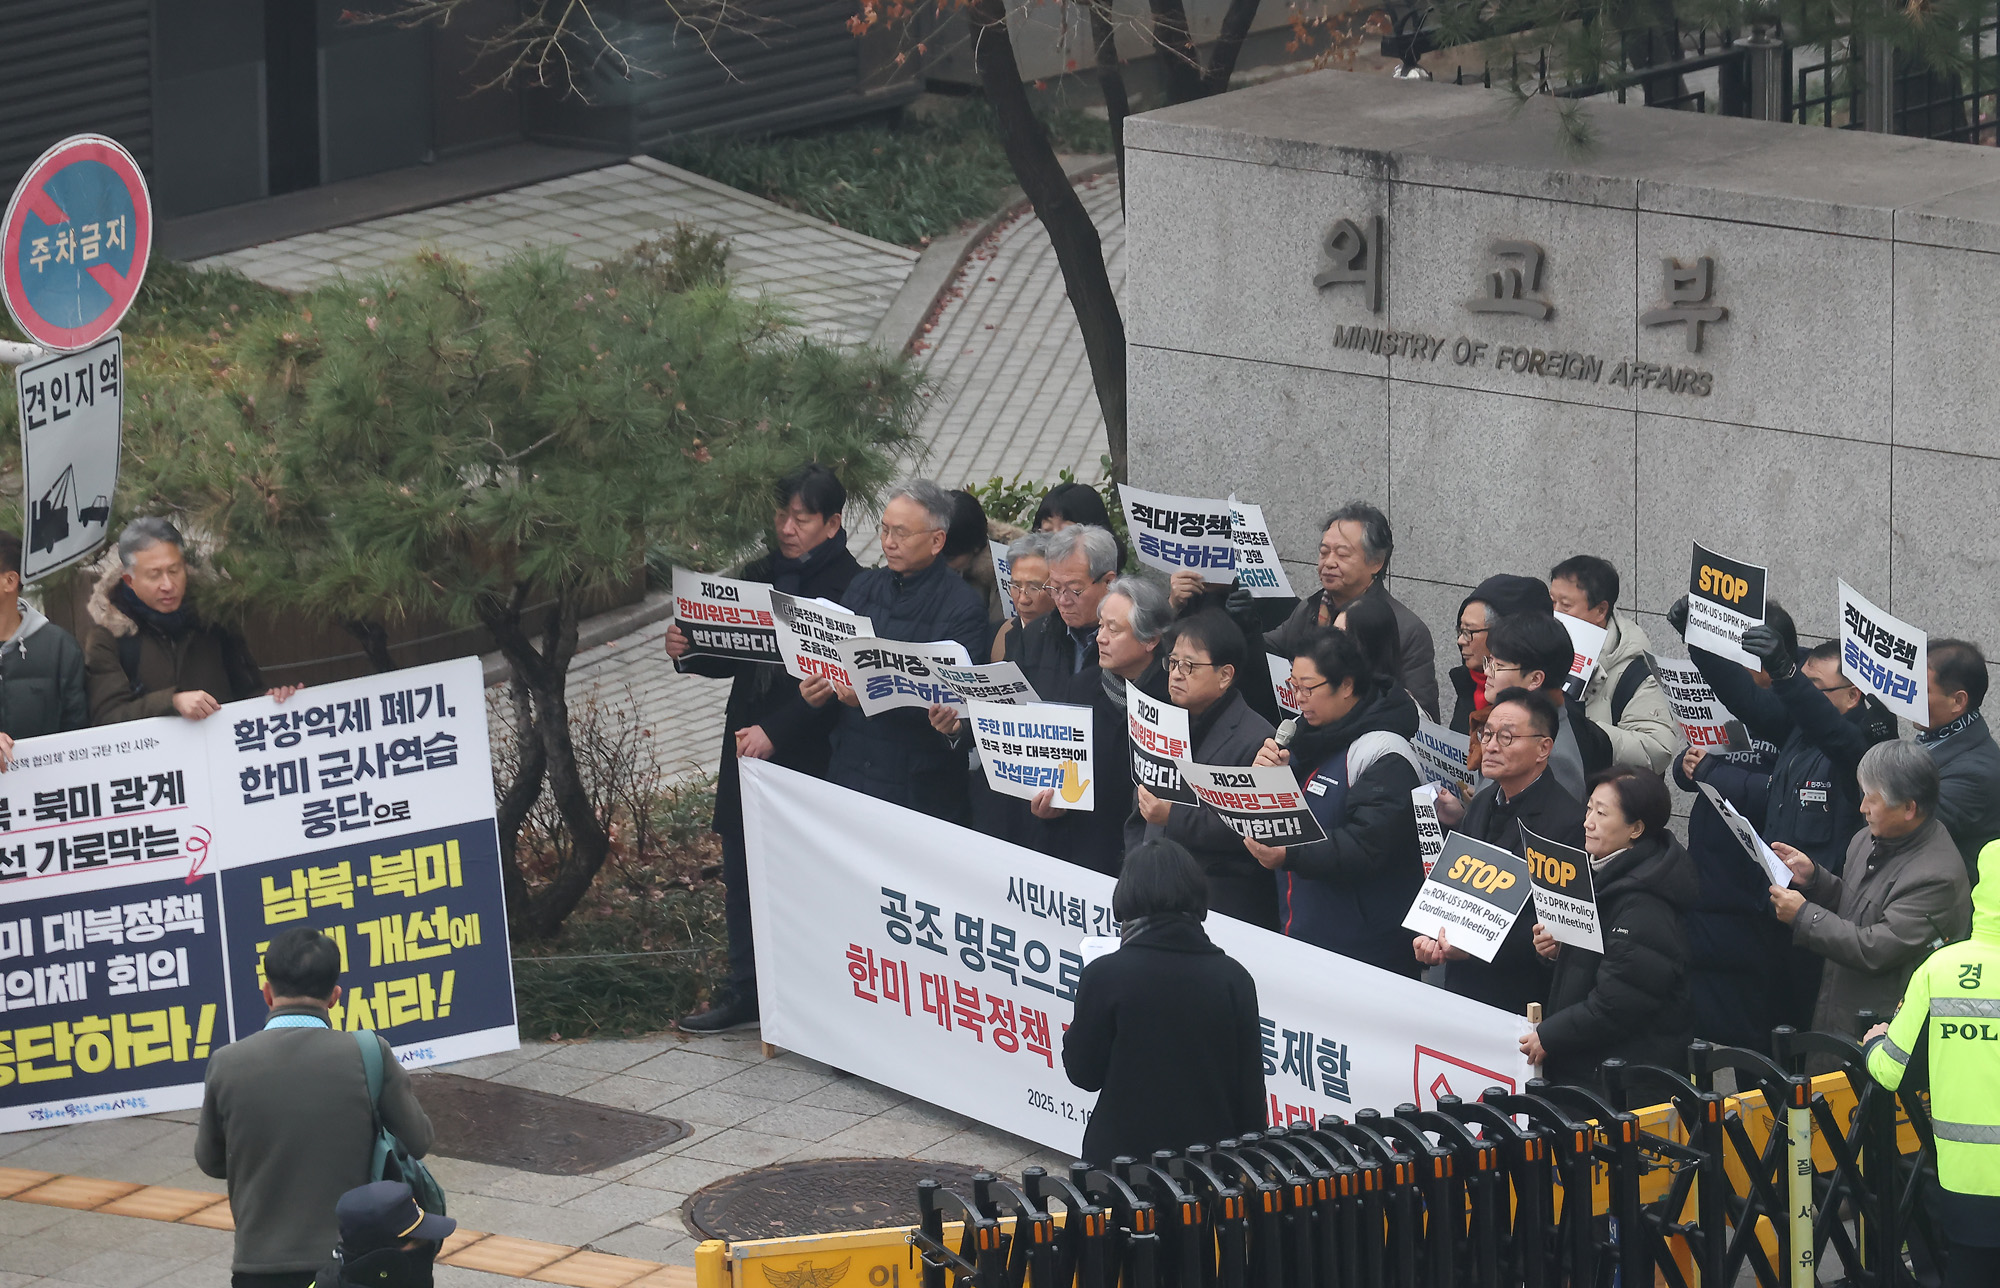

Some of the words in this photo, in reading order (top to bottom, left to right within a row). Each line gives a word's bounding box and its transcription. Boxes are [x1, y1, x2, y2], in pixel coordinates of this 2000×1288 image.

[30, 215, 127, 274] 주차금지
[1333, 324, 1446, 363] MINISTRY
[1452, 336, 1488, 367] OF
[1496, 344, 1603, 384] FOREIGN
[1608, 361, 1714, 397] AFFAIRS
[24, 352, 119, 430] 견인지역
[1130, 502, 1232, 540] 적대정책
[701, 582, 740, 602] 제2의
[1699, 564, 1749, 604] STOP
[782, 603, 824, 627] 대북정책
[790, 620, 812, 637] 한미
[1689, 615, 1728, 639] Coordination
[1723, 612, 1740, 628] DPRK
[692, 629, 776, 653] 반대한다!
[1845, 602, 1918, 670] 적대정책
[937, 667, 990, 684] 외교부는
[1845, 638, 1918, 704] 중단하라
[233, 698, 371, 751] 확장억제
[381, 684, 456, 727] 폐기,
[977, 717, 1000, 736] 주한
[1003, 721, 1016, 738] 미
[1018, 722, 1085, 743] 대사대리는
[1138, 699, 1159, 726] 제2의
[239, 758, 309, 805] 한미
[318, 731, 458, 790] 군사연습
[981, 738, 1000, 752] 한국
[1002, 742, 1023, 757] 정부
[1026, 745, 1088, 762] 대북정책에
[1133, 749, 1181, 791] 반대한다!
[110, 769, 186, 814] 관계
[992, 758, 1065, 790] 간섭말라!
[1210, 772, 1256, 788] 제2의
[301, 791, 412, 839] 중단으로
[35, 826, 181, 874] 가로막는
[1526, 847, 1576, 887] STOP
[260, 839, 463, 926] 남북·북미
[1448, 854, 1516, 894] STOP
[42, 893, 206, 954] 대북정책
[1007, 876, 1087, 934] 시민사회
[1419, 900, 1460, 924] Coordination
[1460, 916, 1500, 942] Meeting!
[1431, 888, 1461, 907] ROK-US's
[1461, 899, 1484, 916] DPRK
[1483, 909, 1510, 930] Policy
[1548, 896, 1570, 912] DPRK
[1570, 902, 1595, 921] Policy
[1558, 914, 1595, 934] Meeting!
[357, 905, 482, 967] 개선에
[880, 886, 948, 956] 공조
[954, 912, 1084, 1003] 명목으로
[0, 961, 96, 1013] 의체'
[107, 947, 190, 996] 회의
[1958, 963, 1983, 990] 경
[845, 943, 911, 1018] 한미
[920, 971, 1054, 1069] 대북정책
[1940, 1023, 1999, 1041] POL
